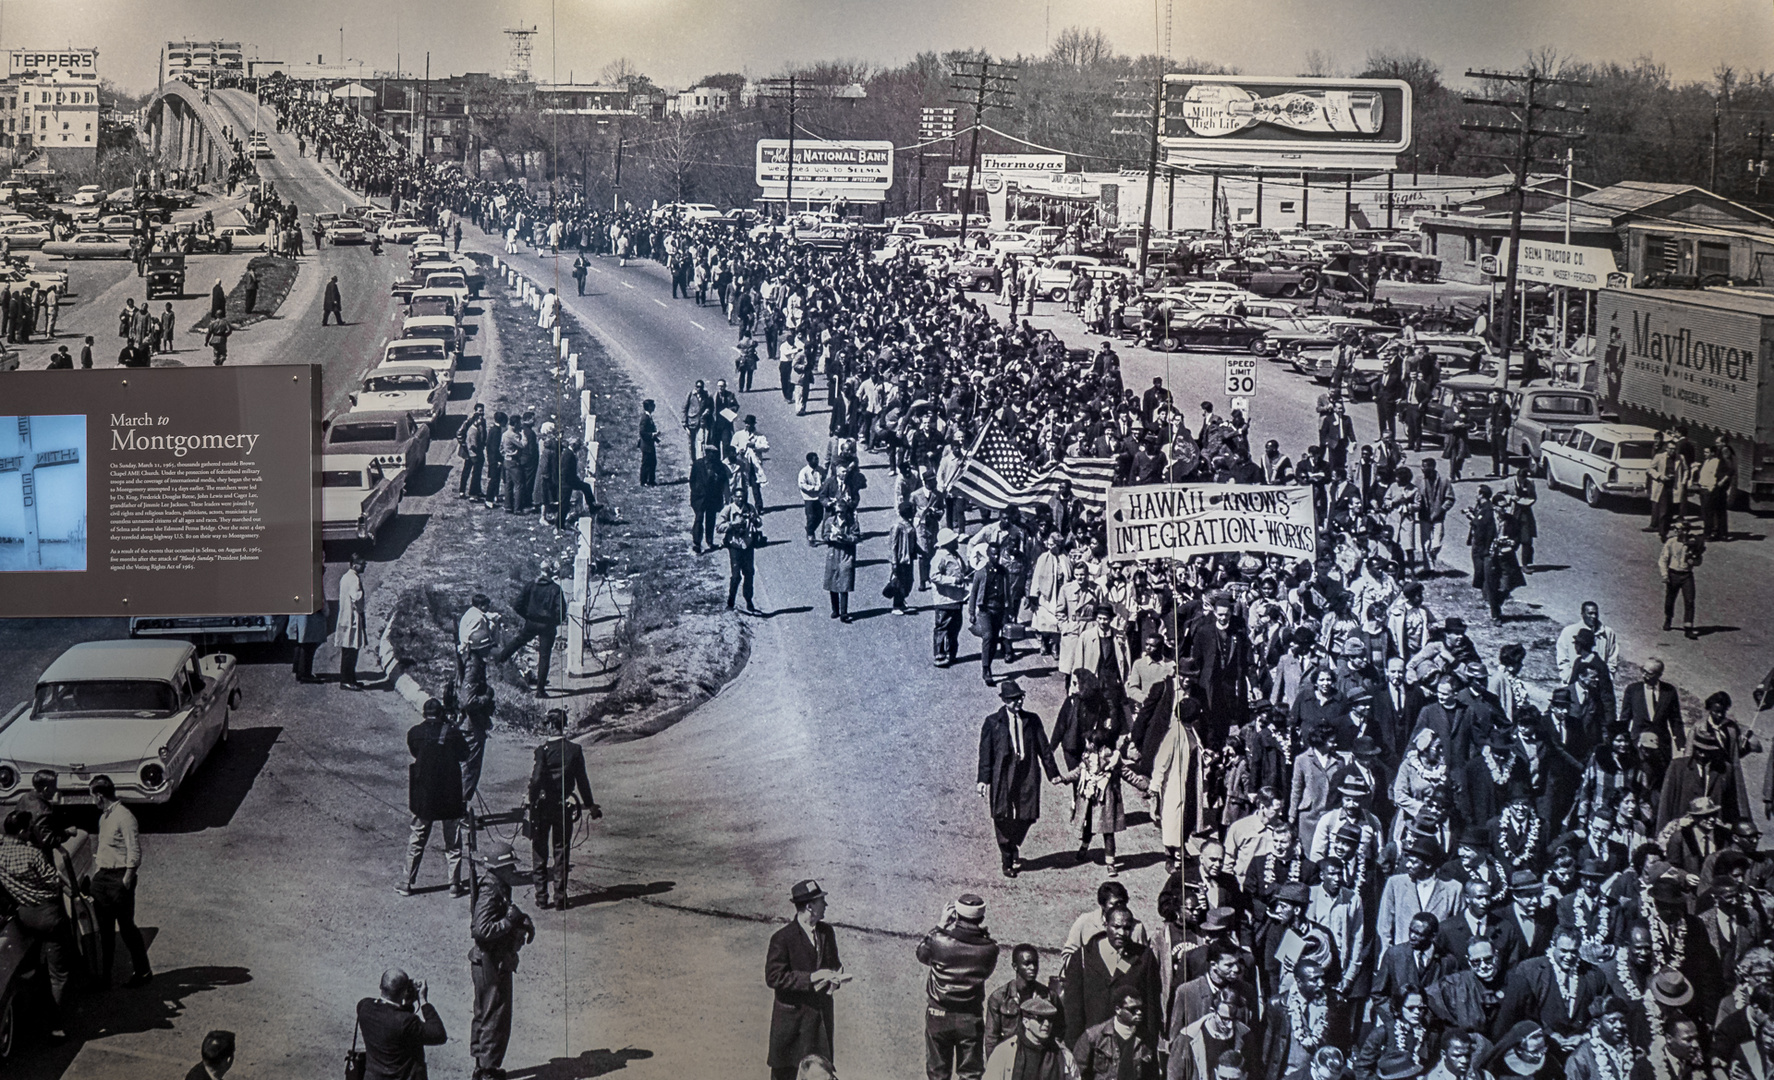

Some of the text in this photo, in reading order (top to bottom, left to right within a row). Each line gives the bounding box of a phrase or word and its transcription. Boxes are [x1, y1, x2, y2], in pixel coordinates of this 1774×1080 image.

[12, 54, 92, 68] TEPPER'S
[1192, 107, 1223, 118] Miller
[1192, 118, 1240, 130] High Life
[804, 150, 856, 162] NATIONAL
[859, 150, 887, 163] BANK
[984, 159, 1063, 170] Thermogas
[1524, 247, 1585, 265] SELMA TRACTOR CO.
[1631, 310, 1753, 382] Mayflower
[1228, 360, 1255, 368] SPEED
[1230, 368, 1251, 376] LIMIT
[1634, 361, 1660, 374] WORLD
[1702, 378, 1736, 393] MOVING
[1228, 377, 1254, 392] 30
[110, 412, 169, 426] March to
[110, 428, 259, 457] Montgomery
[37, 449, 71, 463] WITH
[22, 473, 33, 507] GOD
[1128, 491, 1290, 520] HAWAII KNOWS
[1116, 518, 1314, 553] INTEGRATION WORKS
